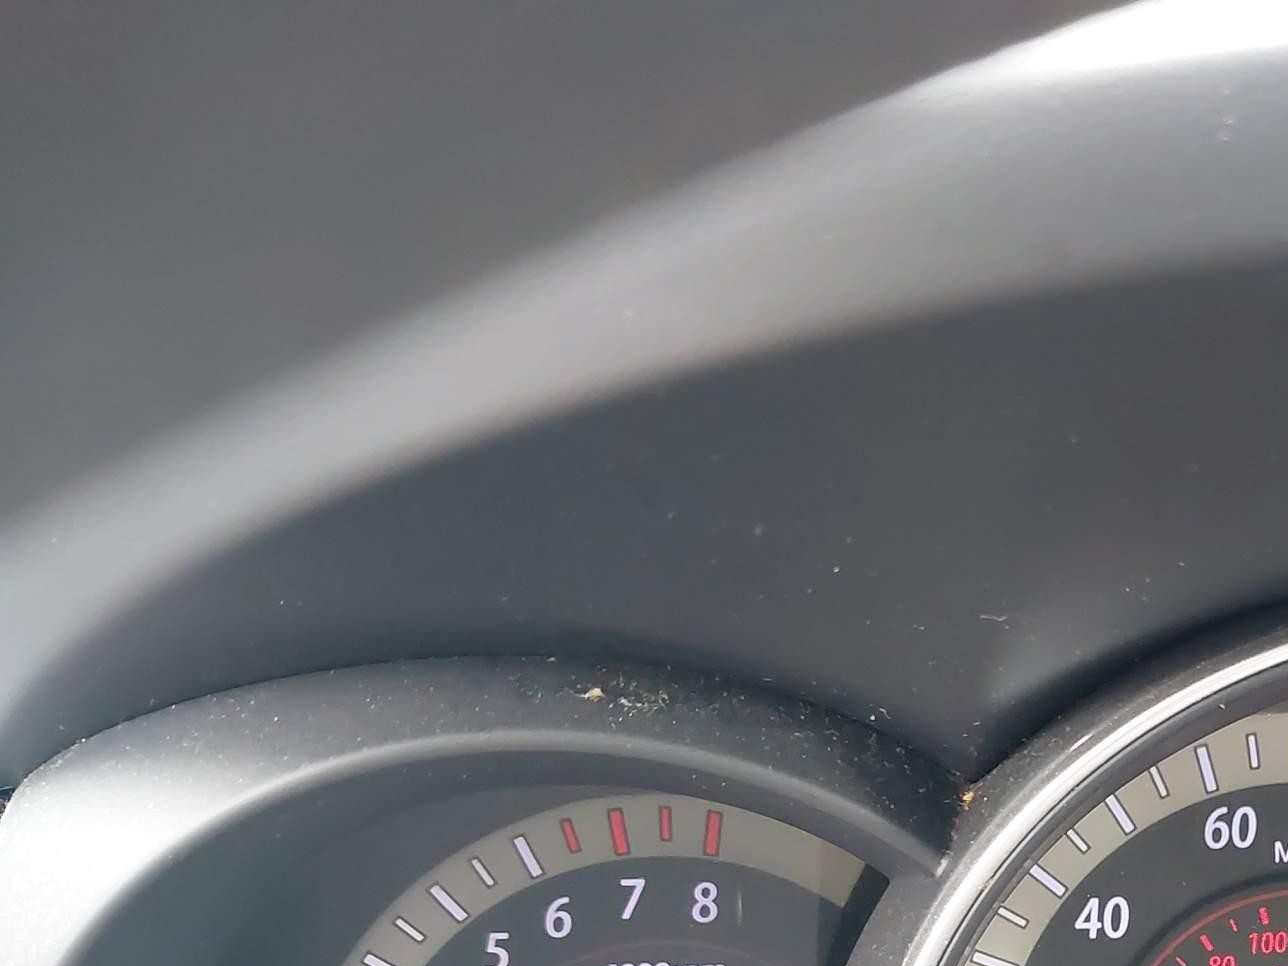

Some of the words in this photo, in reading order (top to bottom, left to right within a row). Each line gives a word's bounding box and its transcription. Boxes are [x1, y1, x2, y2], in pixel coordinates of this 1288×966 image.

[1204, 806, 1257, 850] 60
[544, 896, 572, 938] 6
[620, 878, 646, 920] 7
[691, 882, 719, 924] 8
[1074, 897, 1129, 940] 40
[1248, 931, 1288, 954] 100
